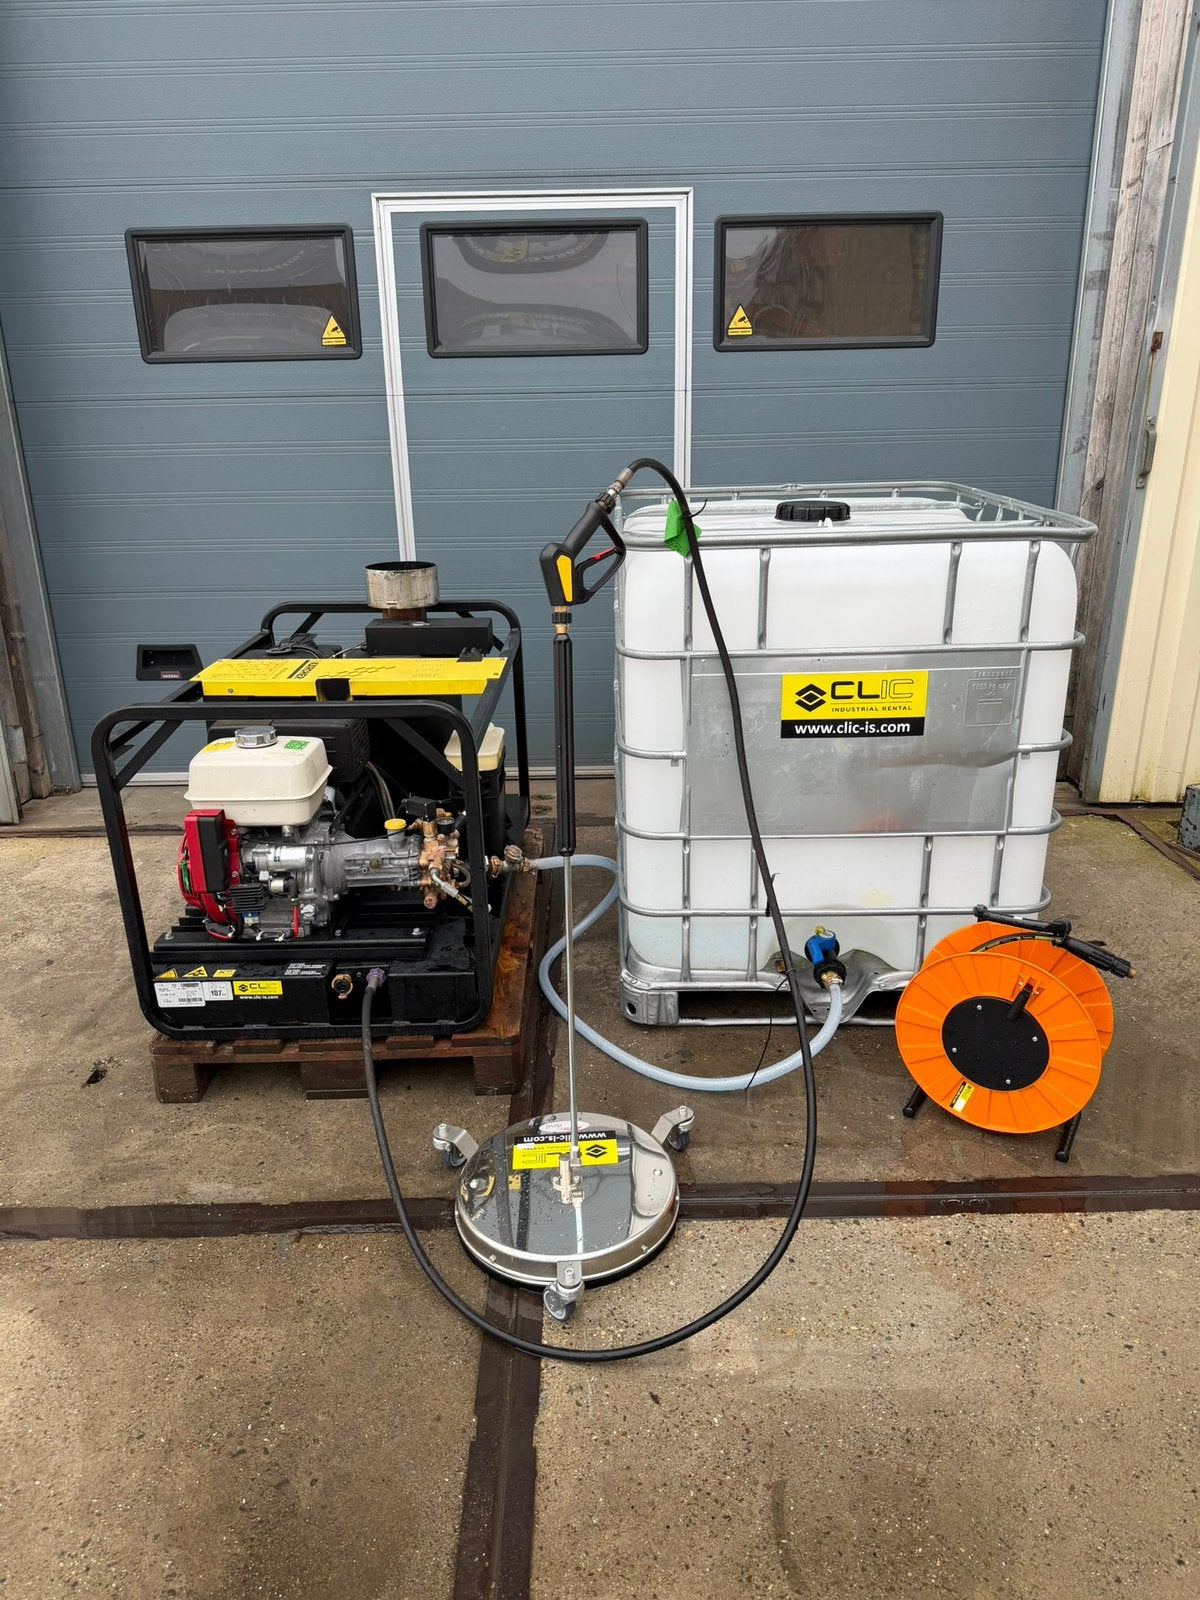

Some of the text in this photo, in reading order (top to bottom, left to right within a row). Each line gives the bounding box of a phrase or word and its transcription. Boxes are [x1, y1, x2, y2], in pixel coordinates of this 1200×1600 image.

[830, 678, 914, 700] CLIC
[794, 720, 911, 735] www.clic-is.com
[523, 1132, 607, 1143] www.lic-is.com
